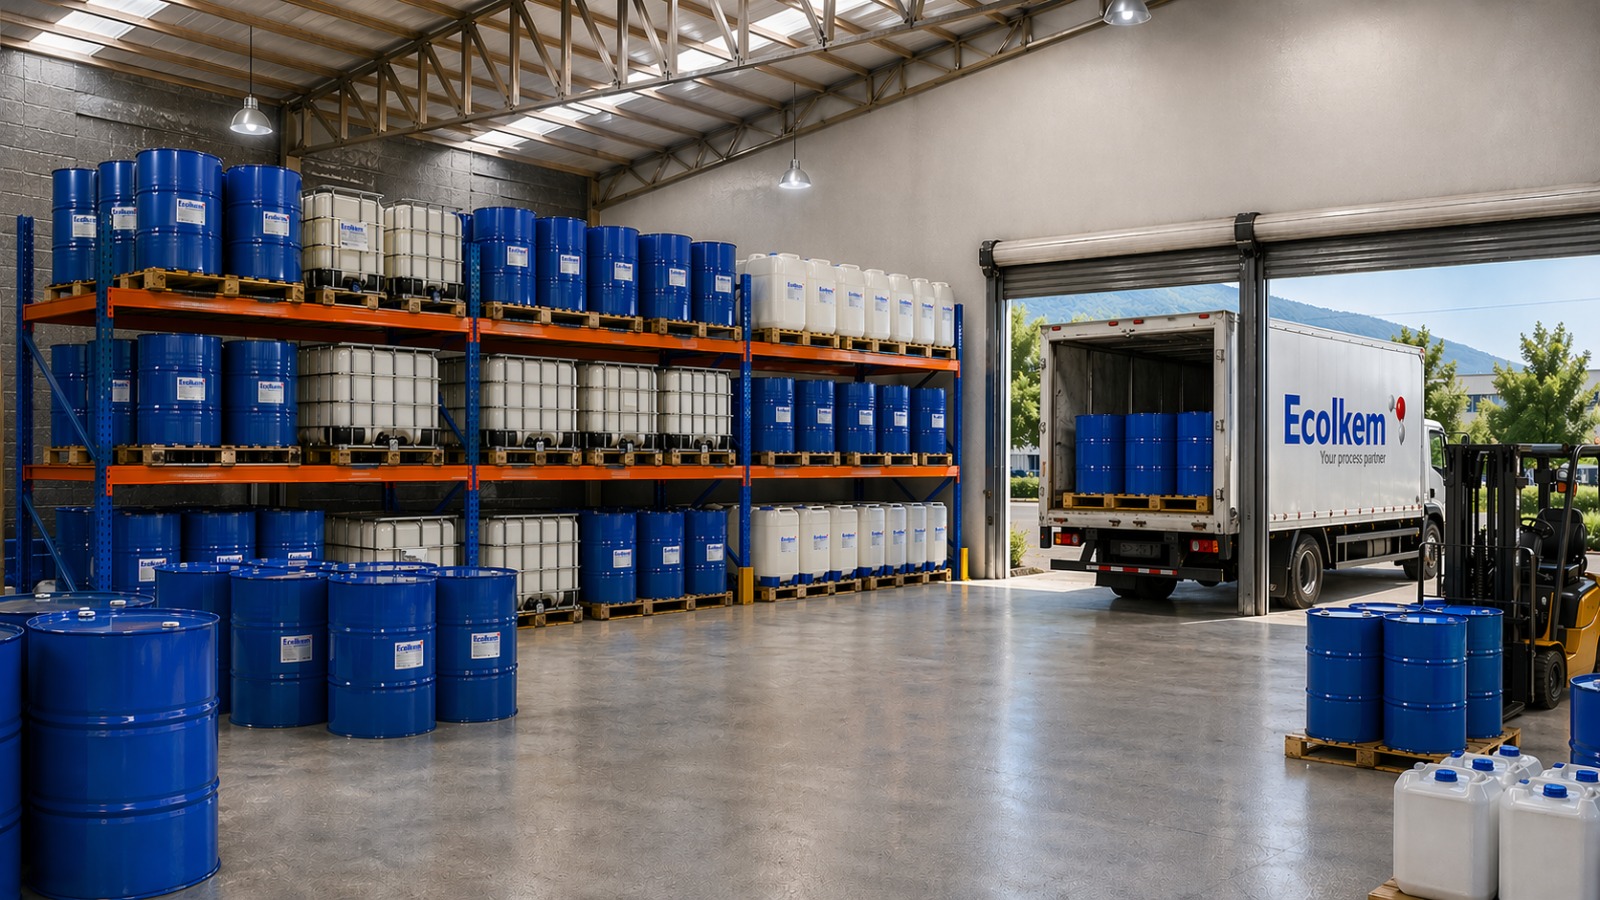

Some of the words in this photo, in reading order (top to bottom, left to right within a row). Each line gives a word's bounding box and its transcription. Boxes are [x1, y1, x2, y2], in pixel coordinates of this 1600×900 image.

[1284, 394, 1386, 446] Ecolkem
[1320, 450, 1337, 465] Your
[1338, 453, 1363, 468] process
[1363, 452, 1386, 468] partner
